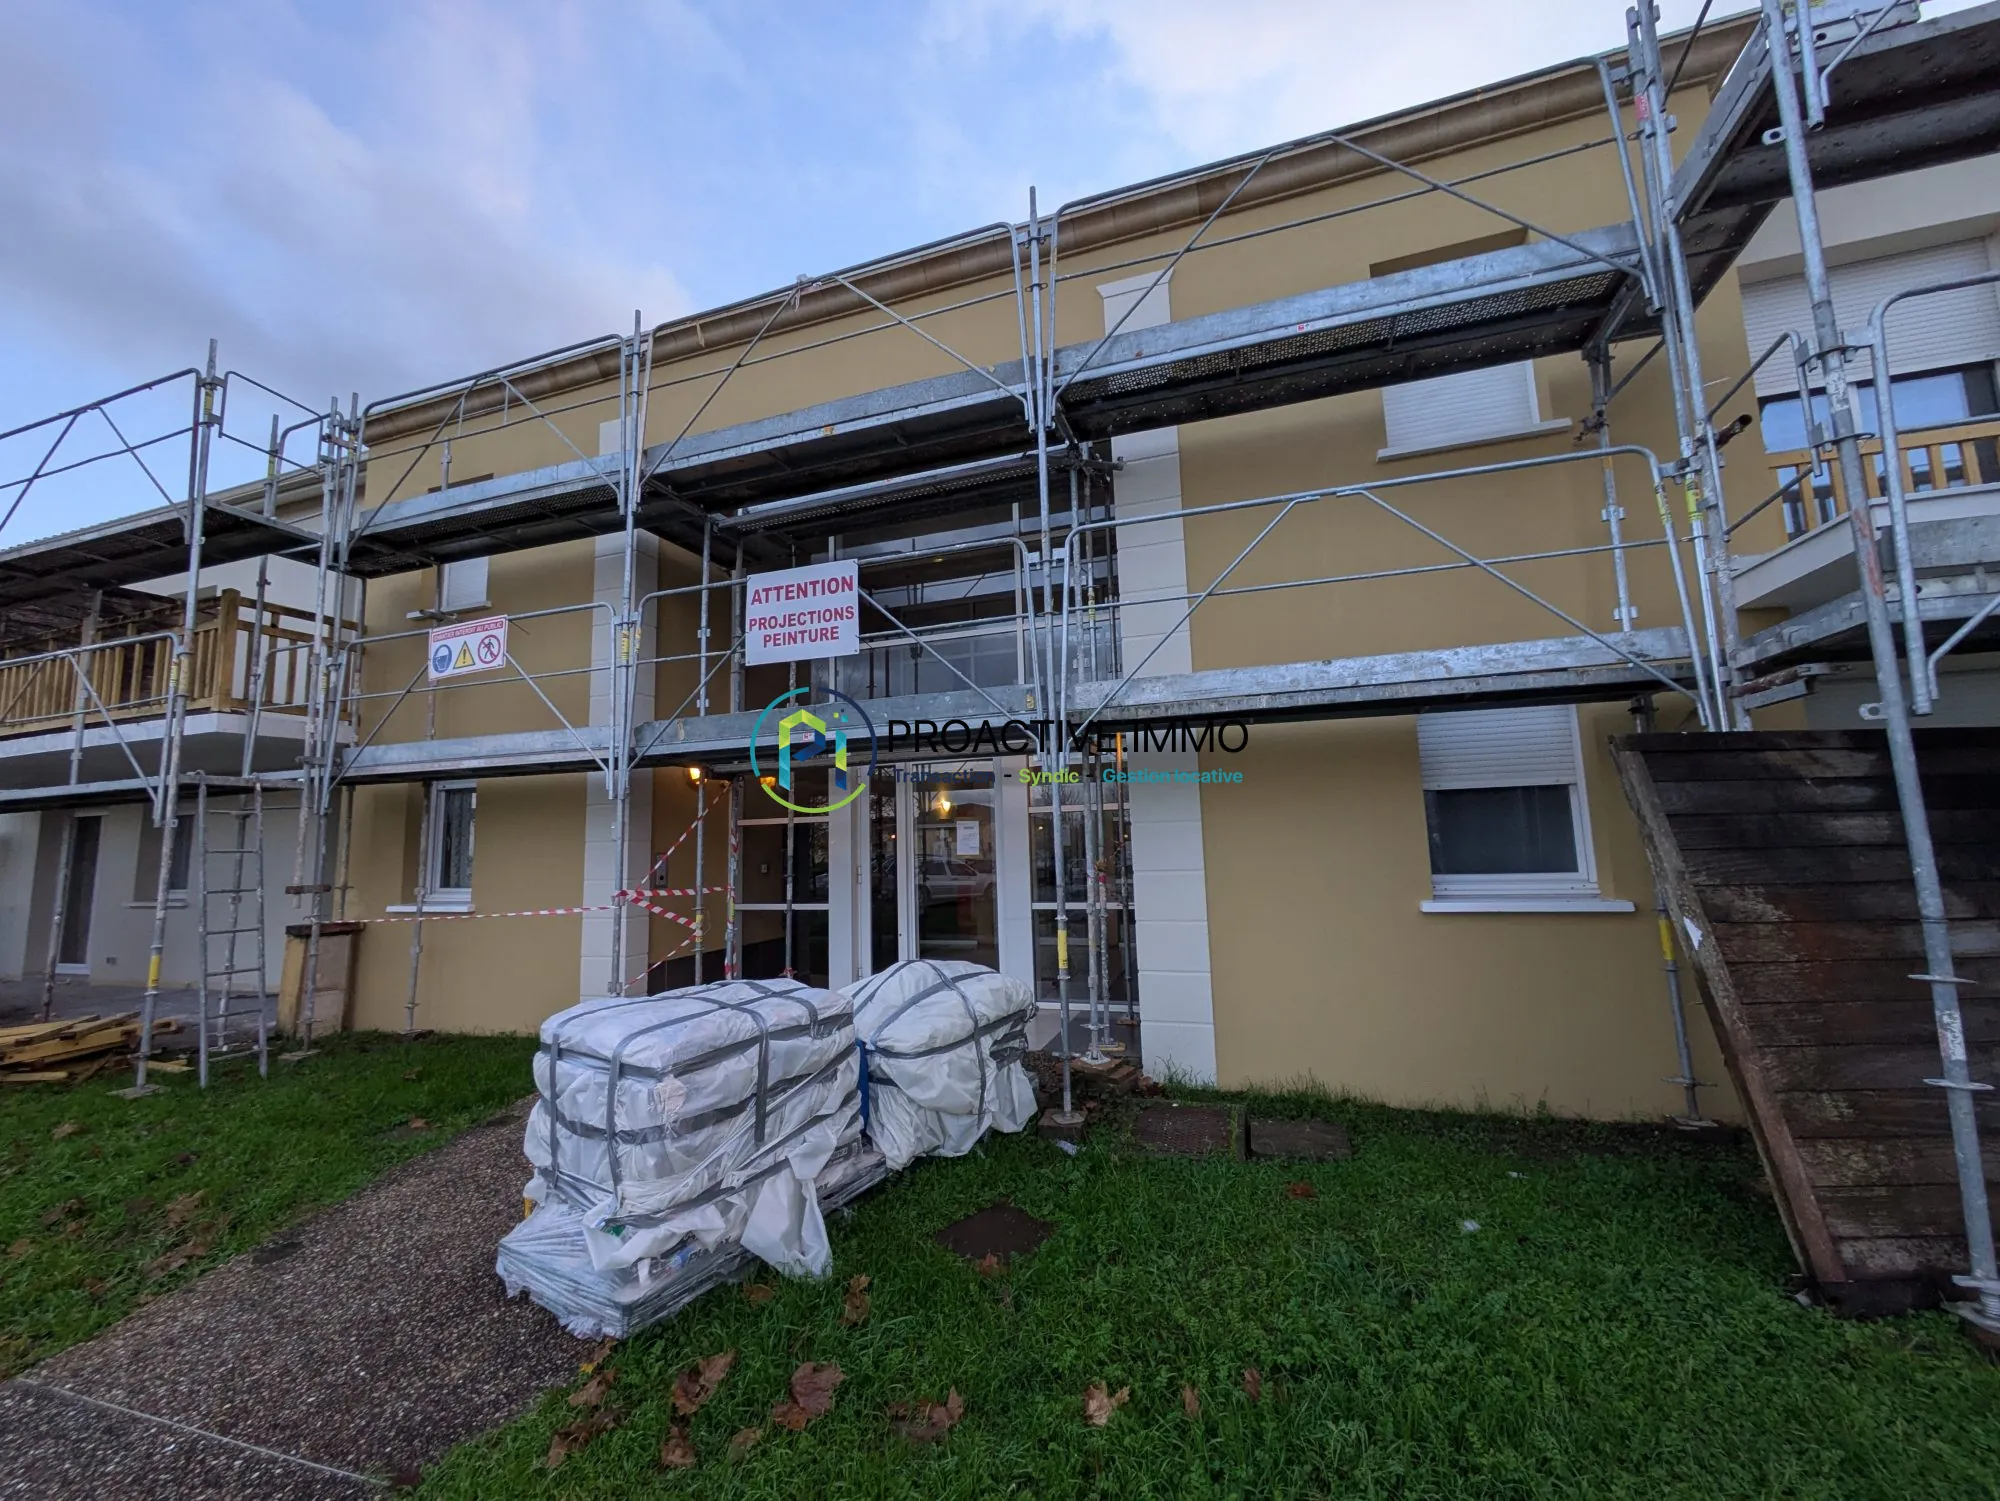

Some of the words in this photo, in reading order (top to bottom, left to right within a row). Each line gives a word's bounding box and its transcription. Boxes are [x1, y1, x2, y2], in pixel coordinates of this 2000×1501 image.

[751, 575, 853, 605] ATTENTION
[484, 621, 502, 630] PUBLIC
[749, 606, 854, 631] PROJECTIONS
[764, 626, 839, 648] PEINTURE
